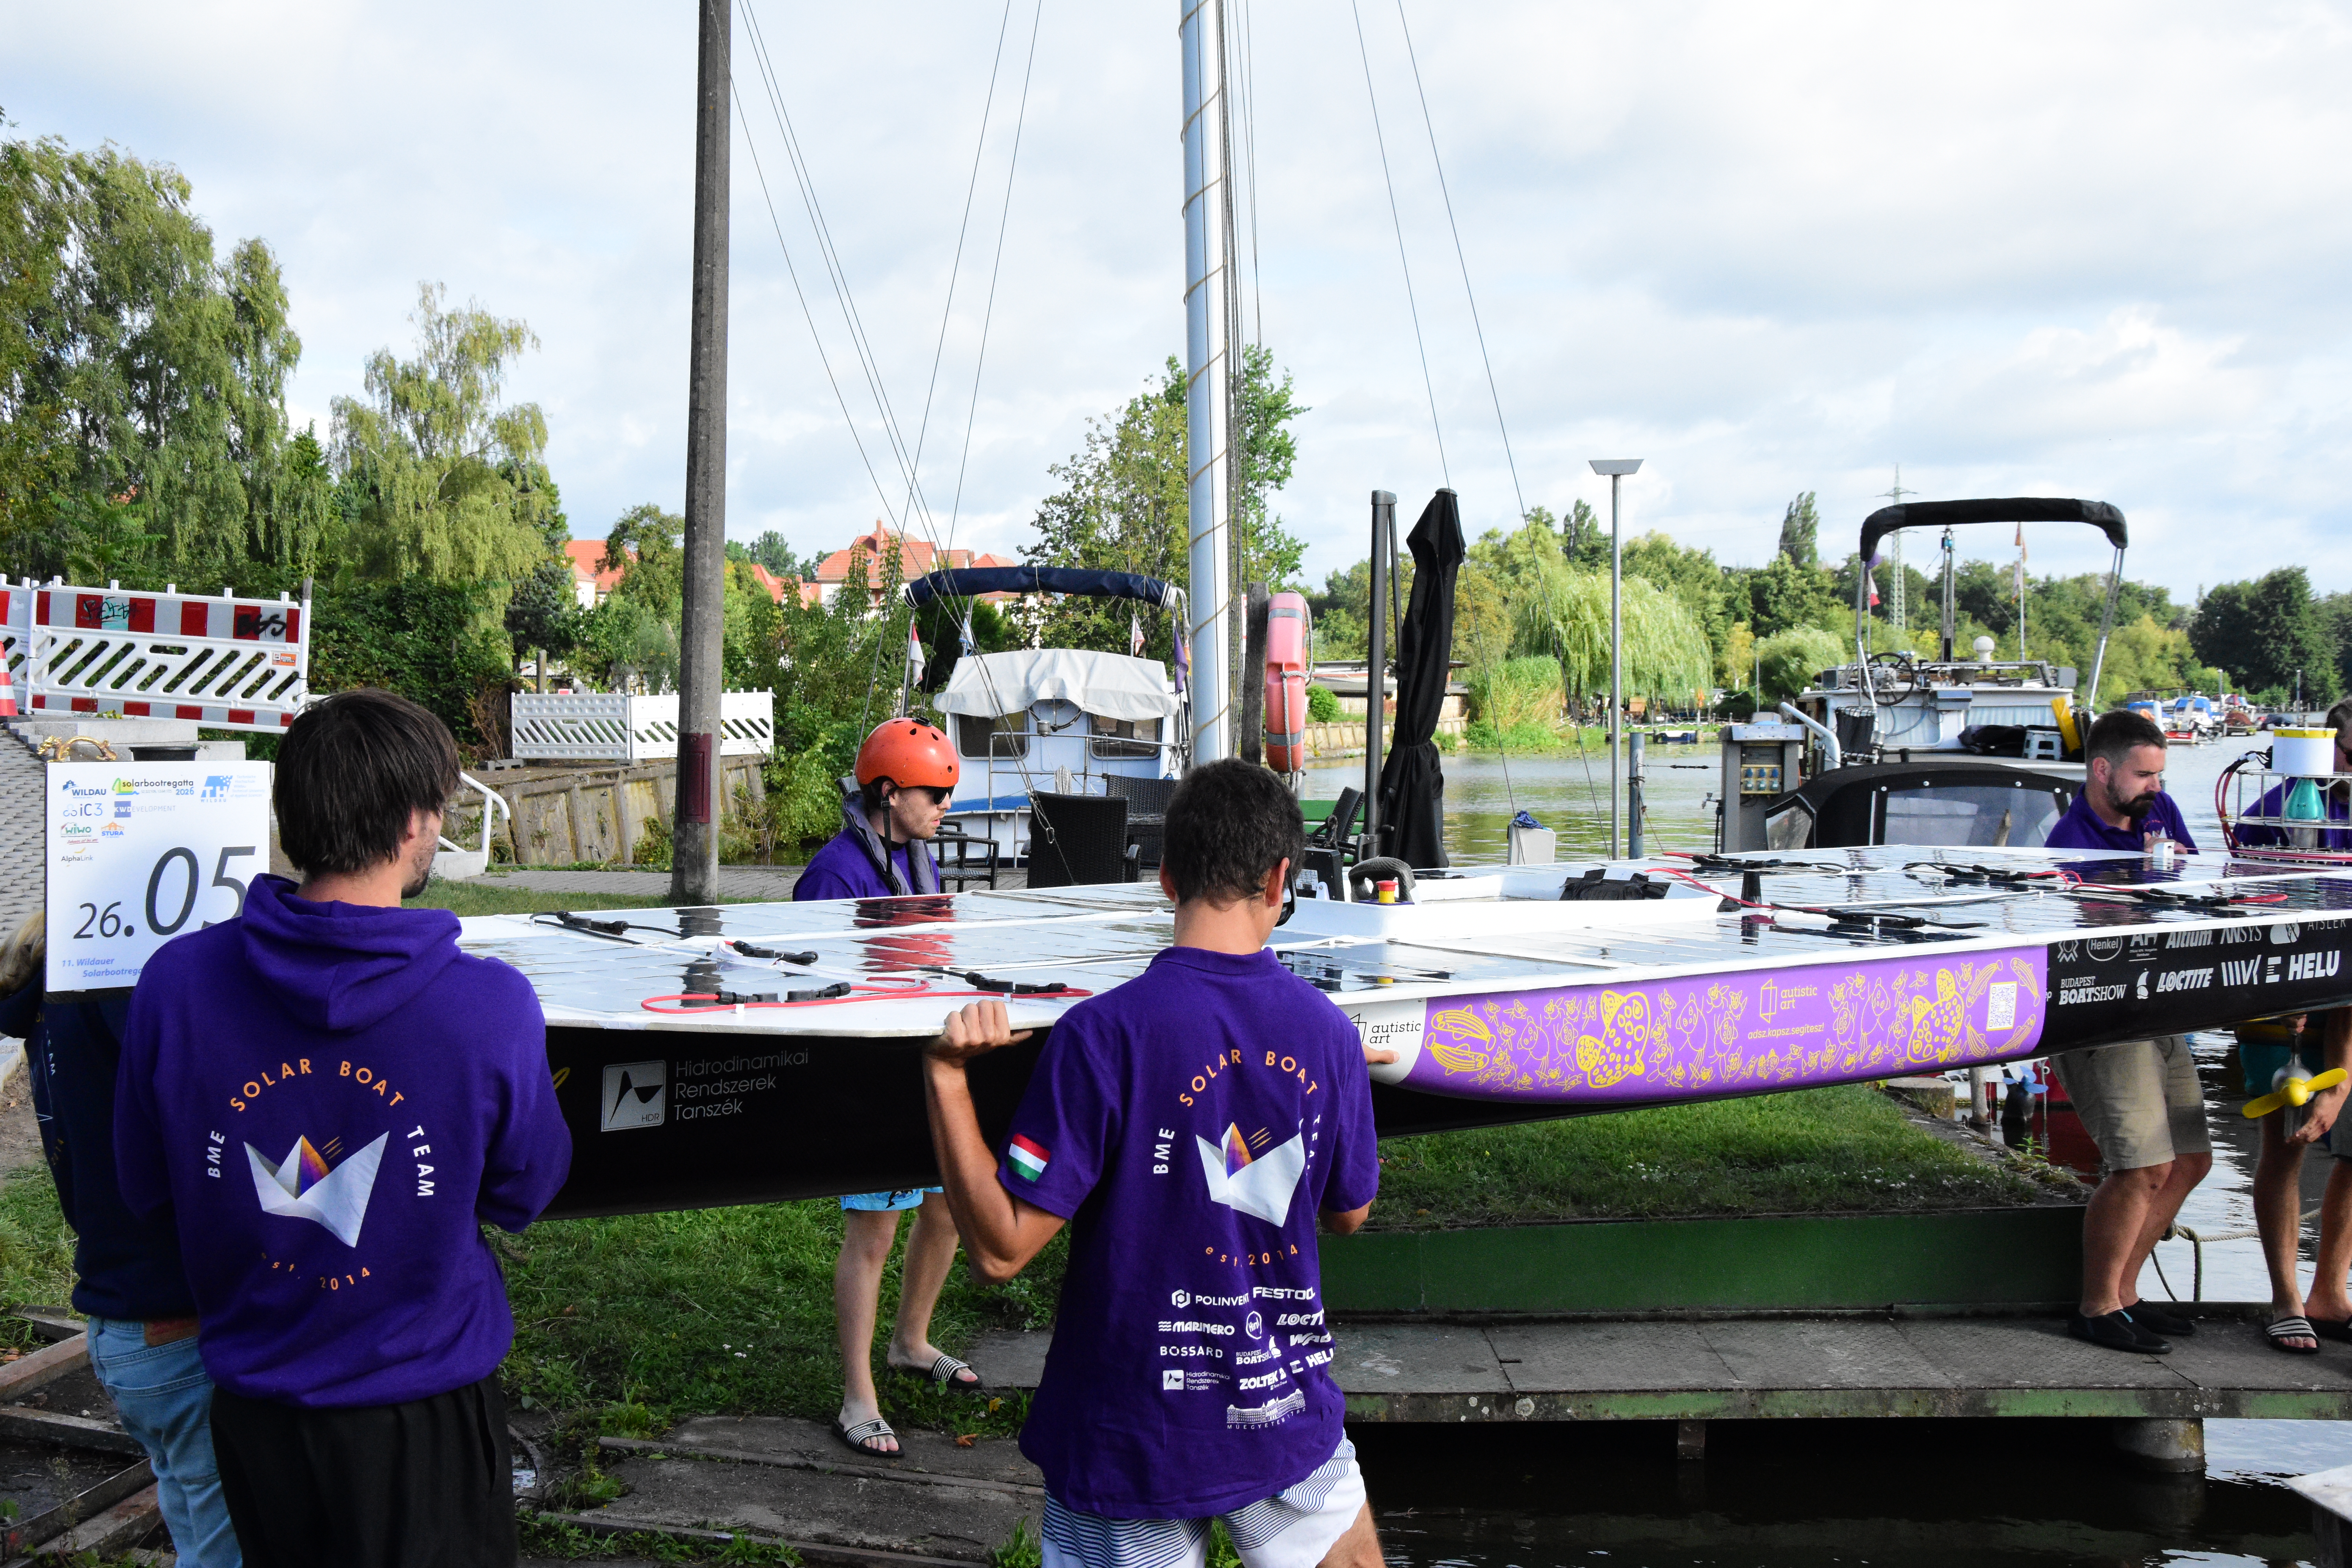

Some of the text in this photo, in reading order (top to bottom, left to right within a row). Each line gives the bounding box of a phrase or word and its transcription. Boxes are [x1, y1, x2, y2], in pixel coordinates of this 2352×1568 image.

[122, 779, 194, 788] solarbootregatta
[176, 787, 194, 795] 2026
[2091, 937, 2119, 951] Henkel
[76, 958, 115, 966] Wildauer
[2288, 950, 2340, 981] HELU
[2060, 976, 2096, 989] BUDAPEST
[2156, 967, 2214, 992] LOCTITE
[1781, 985, 1818, 998] autistic
[2059, 984, 2127, 1005] BOATSHOW
[1780, 998, 1796, 1010] art
[1372, 1020, 1421, 1033] autistic
[1369, 1034, 1391, 1044] art
[676, 1048, 808, 1078] Hidrodinamikai
[675, 1074, 777, 1099] Rendszerek
[674, 1098, 743, 1120] Tanszék
[1153, 1127, 1175, 1174] BME
[1179, 1049, 1241, 1107] SOLAR
[1266, 1051, 1318, 1094] BOAT
[642, 1112, 660, 1122] HDR
[207, 1058, 435, 1196] BME SOLAR BOAT TEAM
[1248, 1244, 1298, 1265] 2014
[319, 1267, 370, 1290] 2014
[1196, 1292, 1249, 1306] POLINVENT
[1172, 1321, 1235, 1336] MARINERO
[1160, 1346, 1223, 1358] BOSSARD
[1186, 1371, 1231, 1380] Hidrodinamikai
[1240, 1370, 1279, 1390] ZOLTEK
